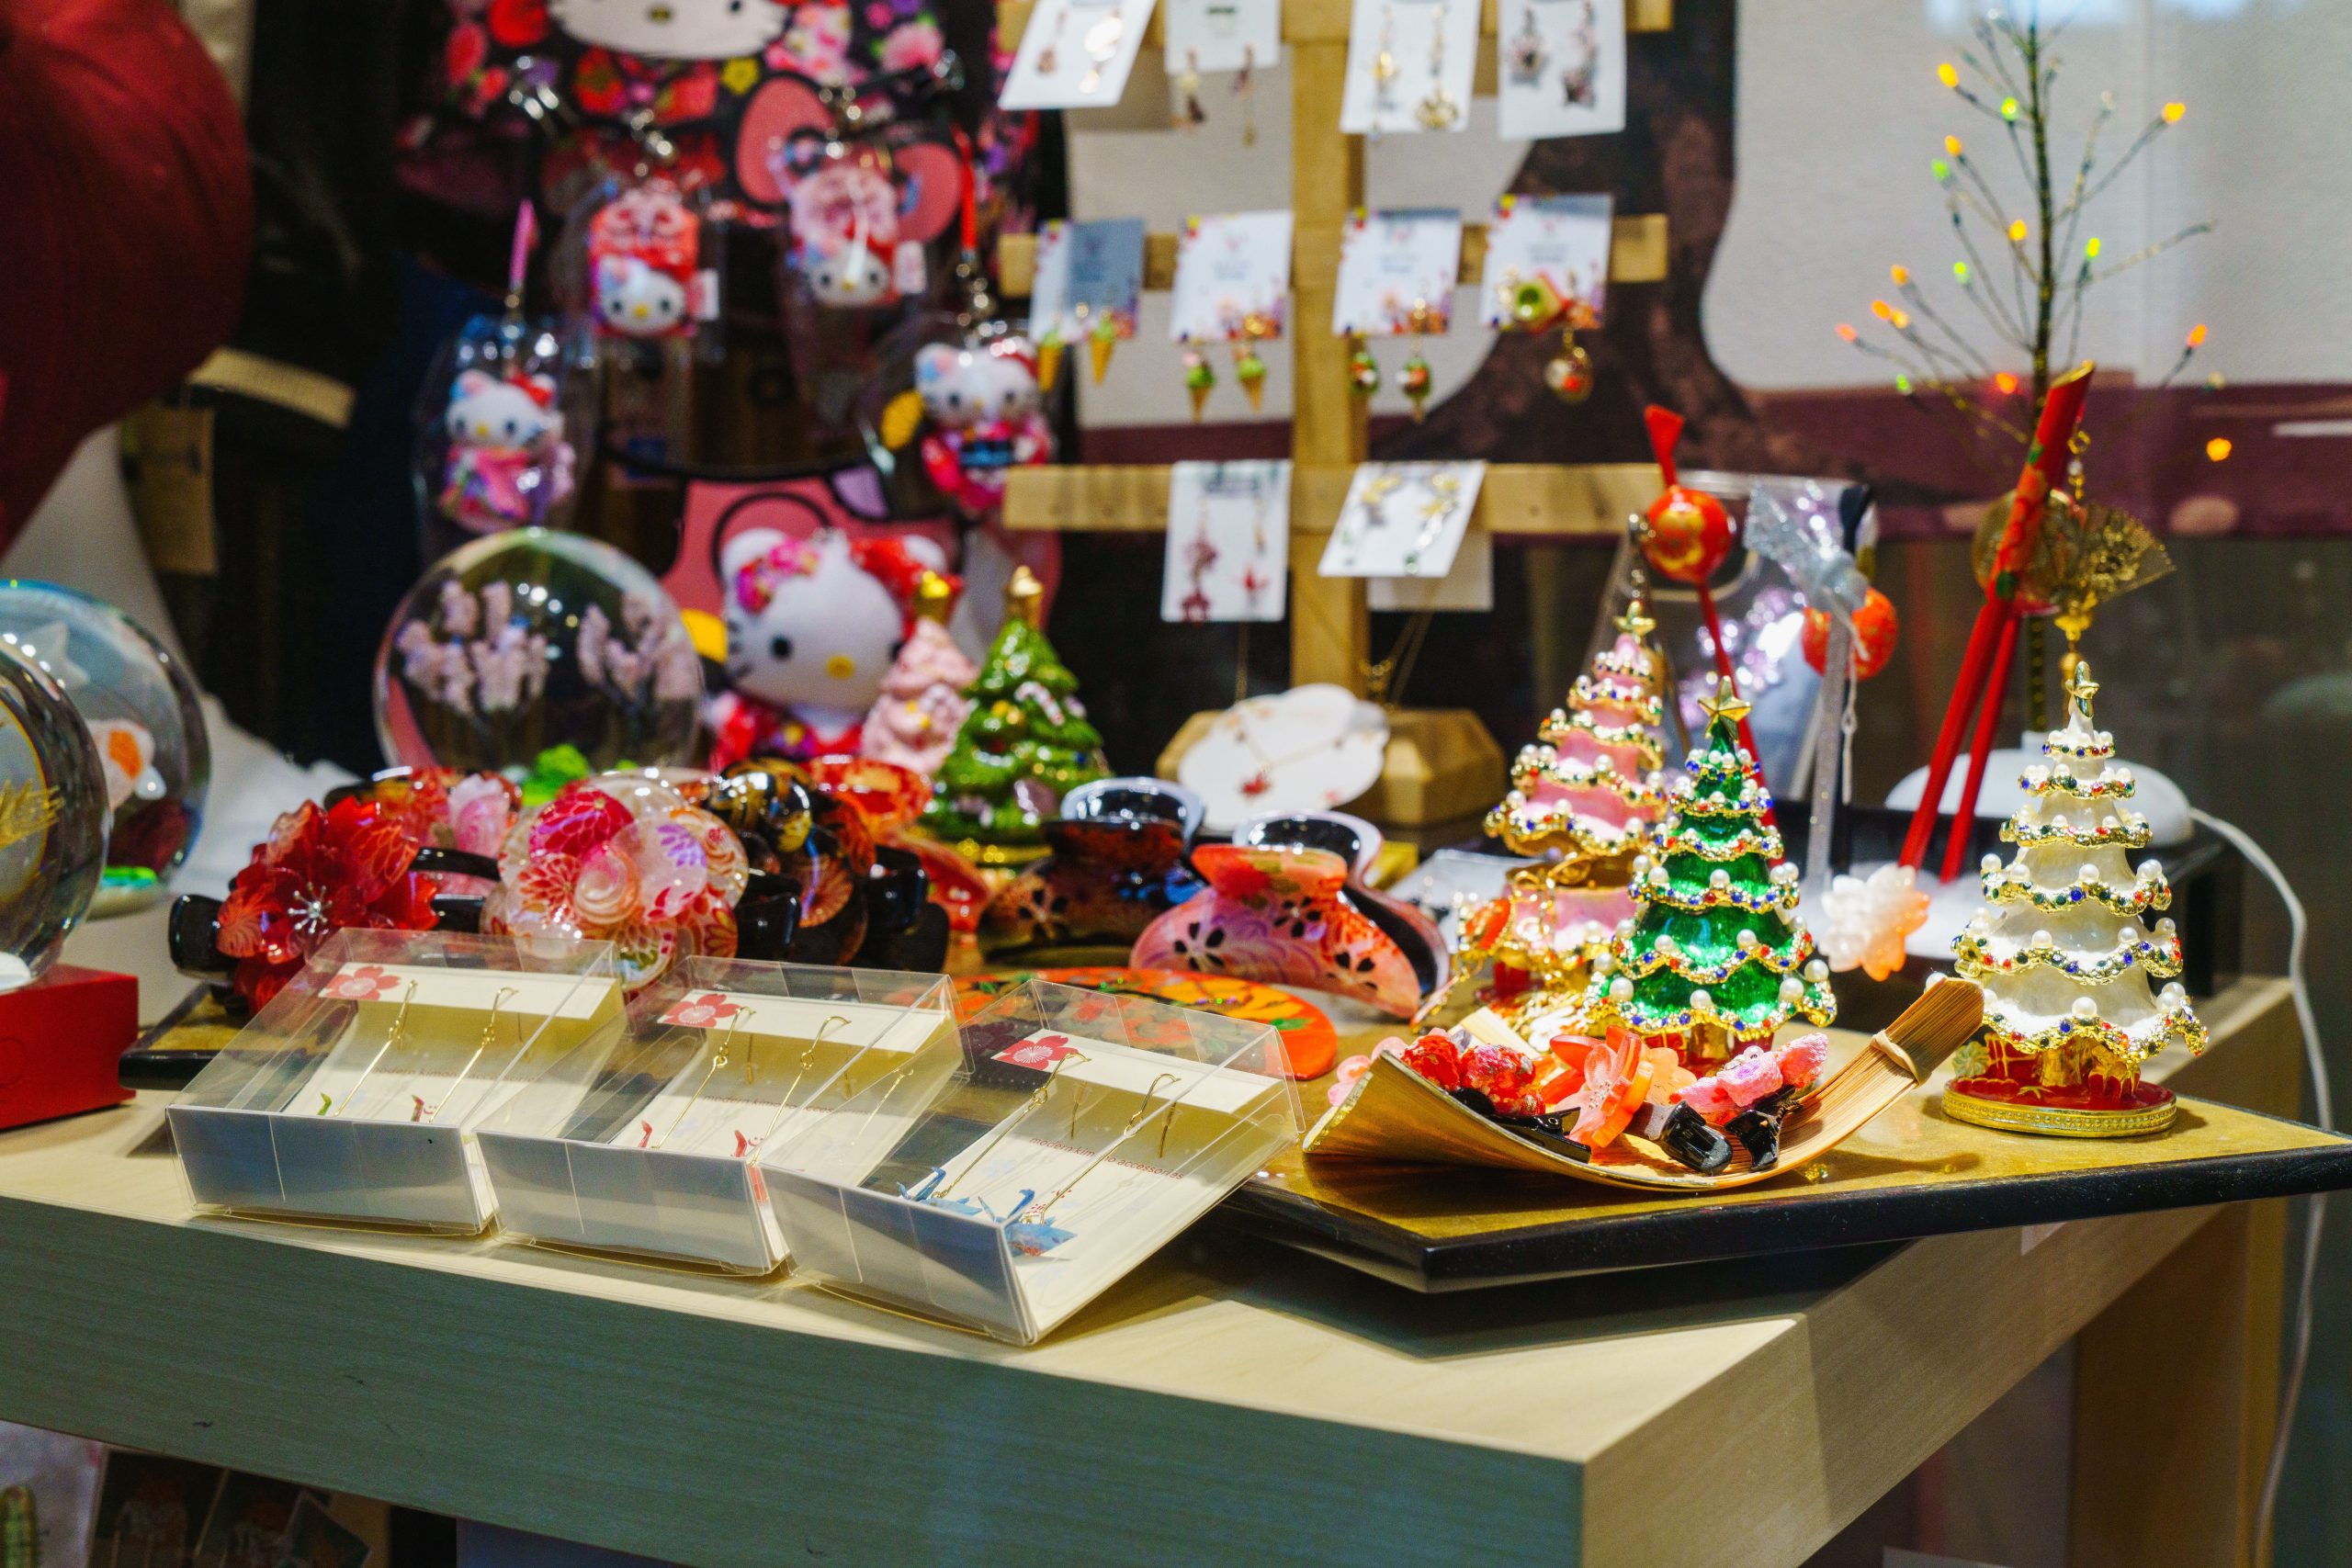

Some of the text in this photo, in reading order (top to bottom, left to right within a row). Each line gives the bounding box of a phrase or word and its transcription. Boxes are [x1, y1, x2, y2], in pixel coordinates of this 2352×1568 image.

[1029, 1137, 1184, 1179] modern kimo accessories
